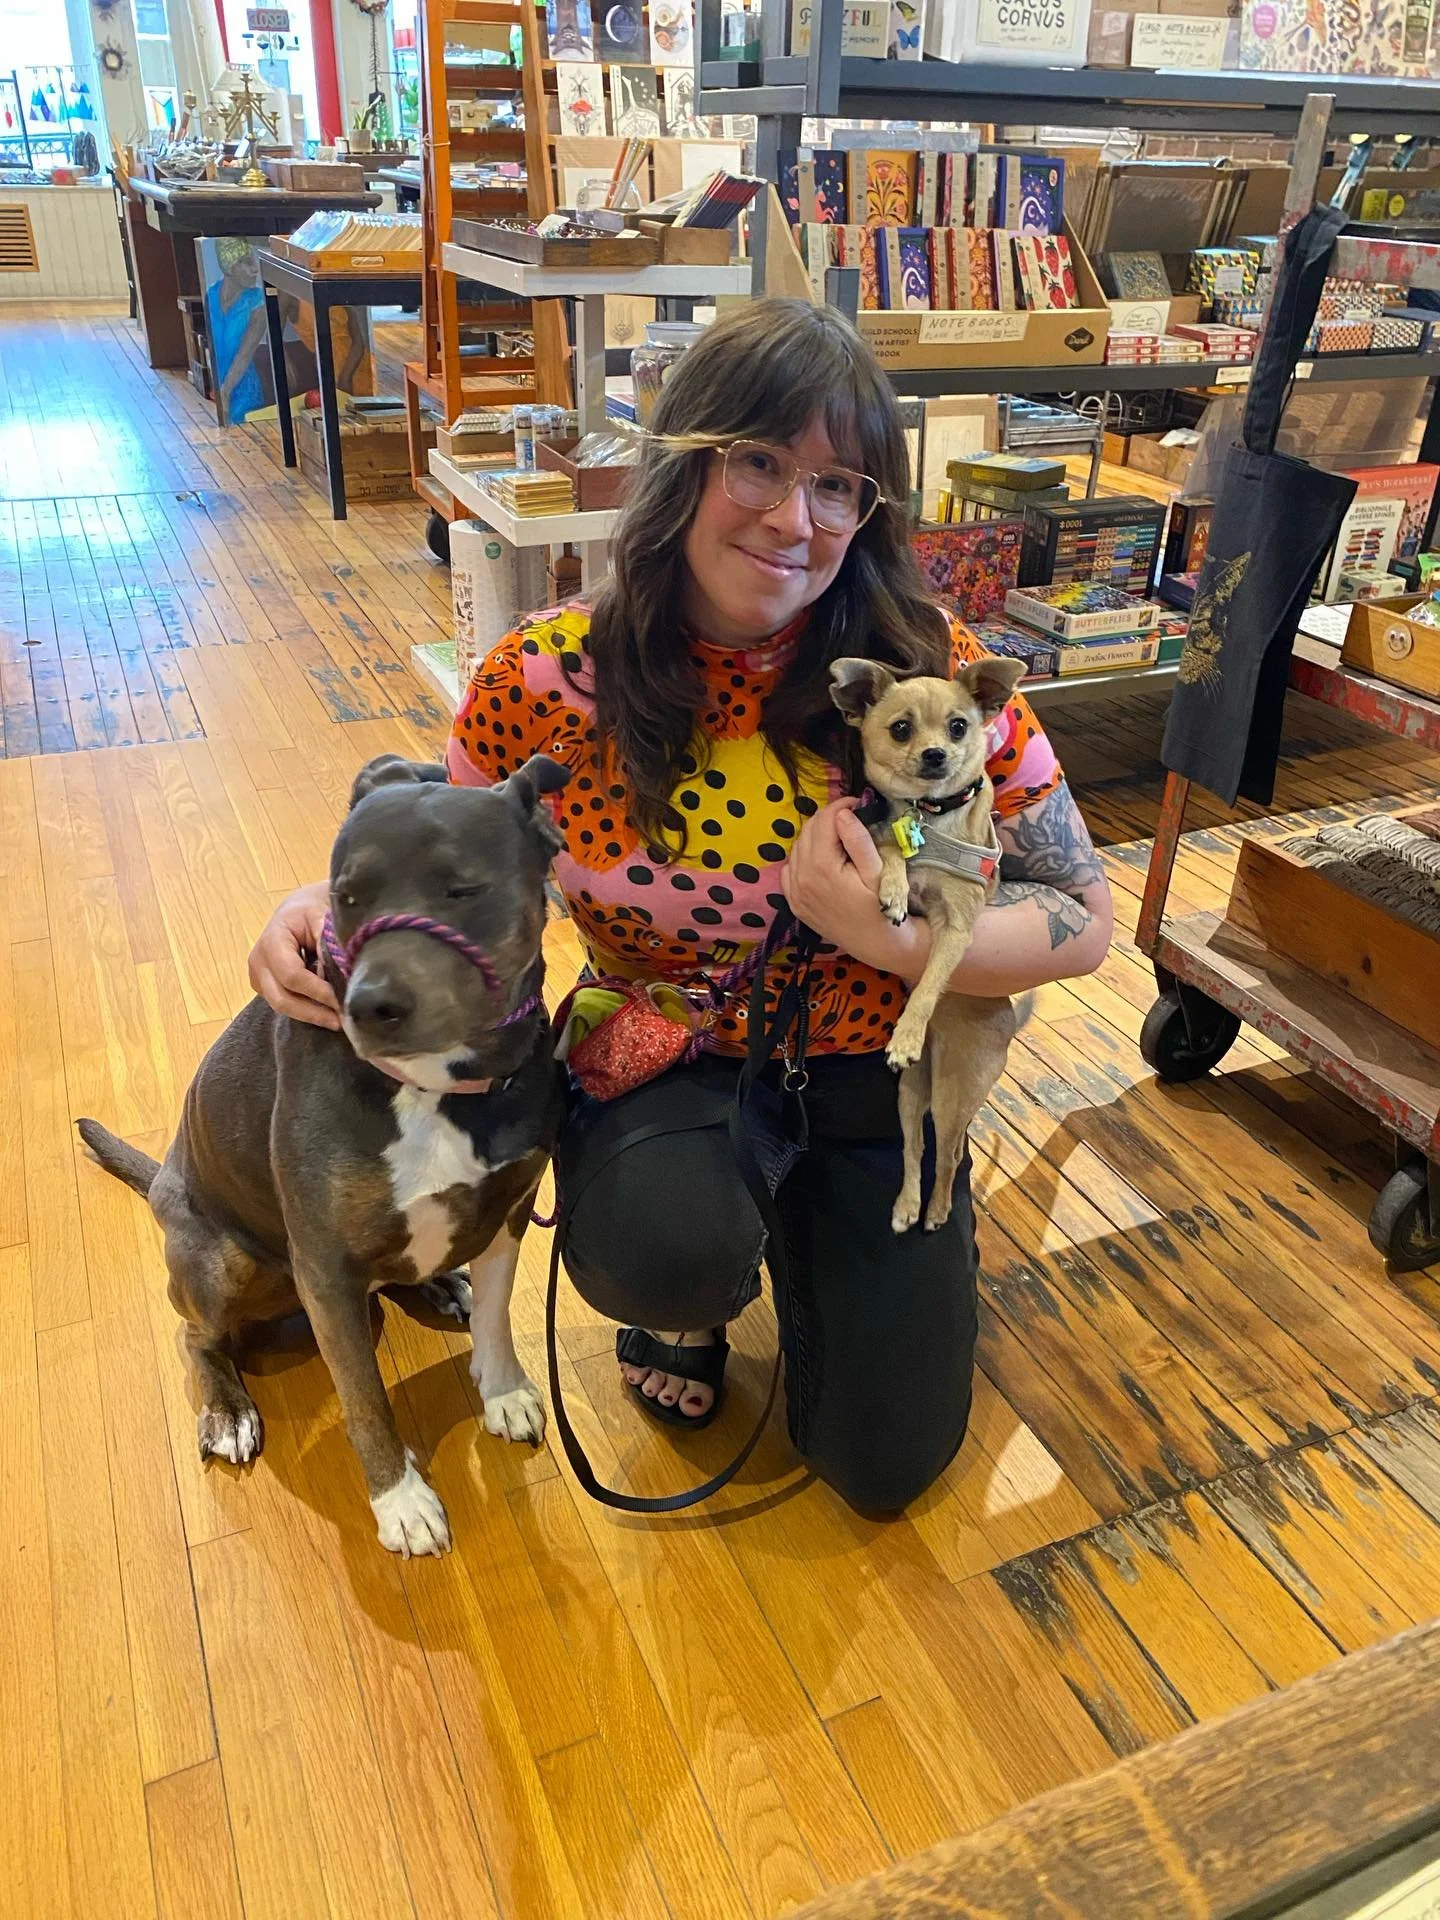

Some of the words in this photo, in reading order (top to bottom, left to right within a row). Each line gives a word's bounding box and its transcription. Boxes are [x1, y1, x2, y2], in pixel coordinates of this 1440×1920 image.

[998, 7, 1065, 28] CORVUS
[928, 316, 1012, 329] NOTEBOOKS
[1075, 614, 1132, 629] BUTTERFLIES
[1084, 652, 1106, 663] Zodiac
[1107, 651, 1134, 660] Flowers
